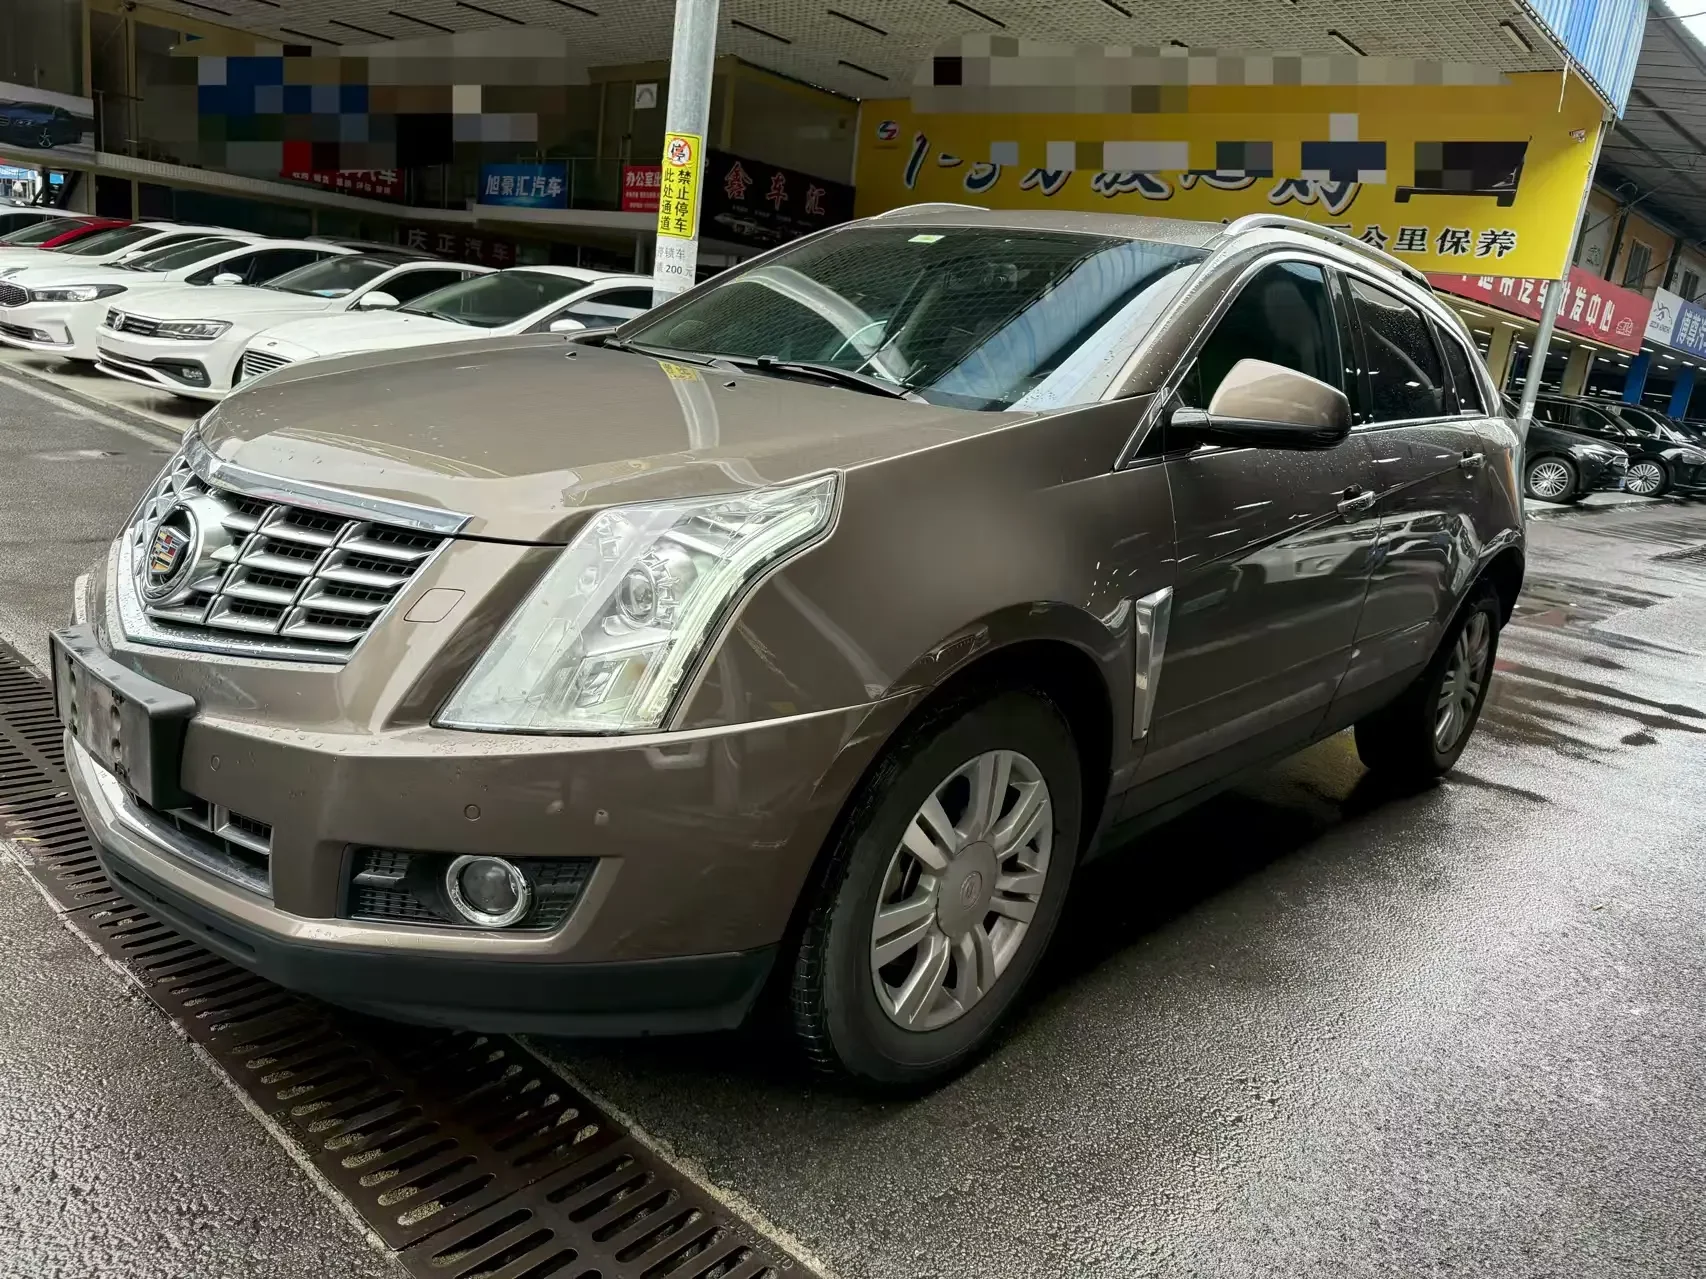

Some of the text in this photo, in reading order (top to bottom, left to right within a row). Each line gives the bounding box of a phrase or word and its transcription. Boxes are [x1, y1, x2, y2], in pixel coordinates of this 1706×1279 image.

[485, 174, 563, 198] 旭豪汇汽车
[660, 167, 675, 231] 此处通道
[674, 169, 692, 232] 禁止停车
[407, 228, 511, 262] 庆正汽车
[665, 264, 683, 275] 200
